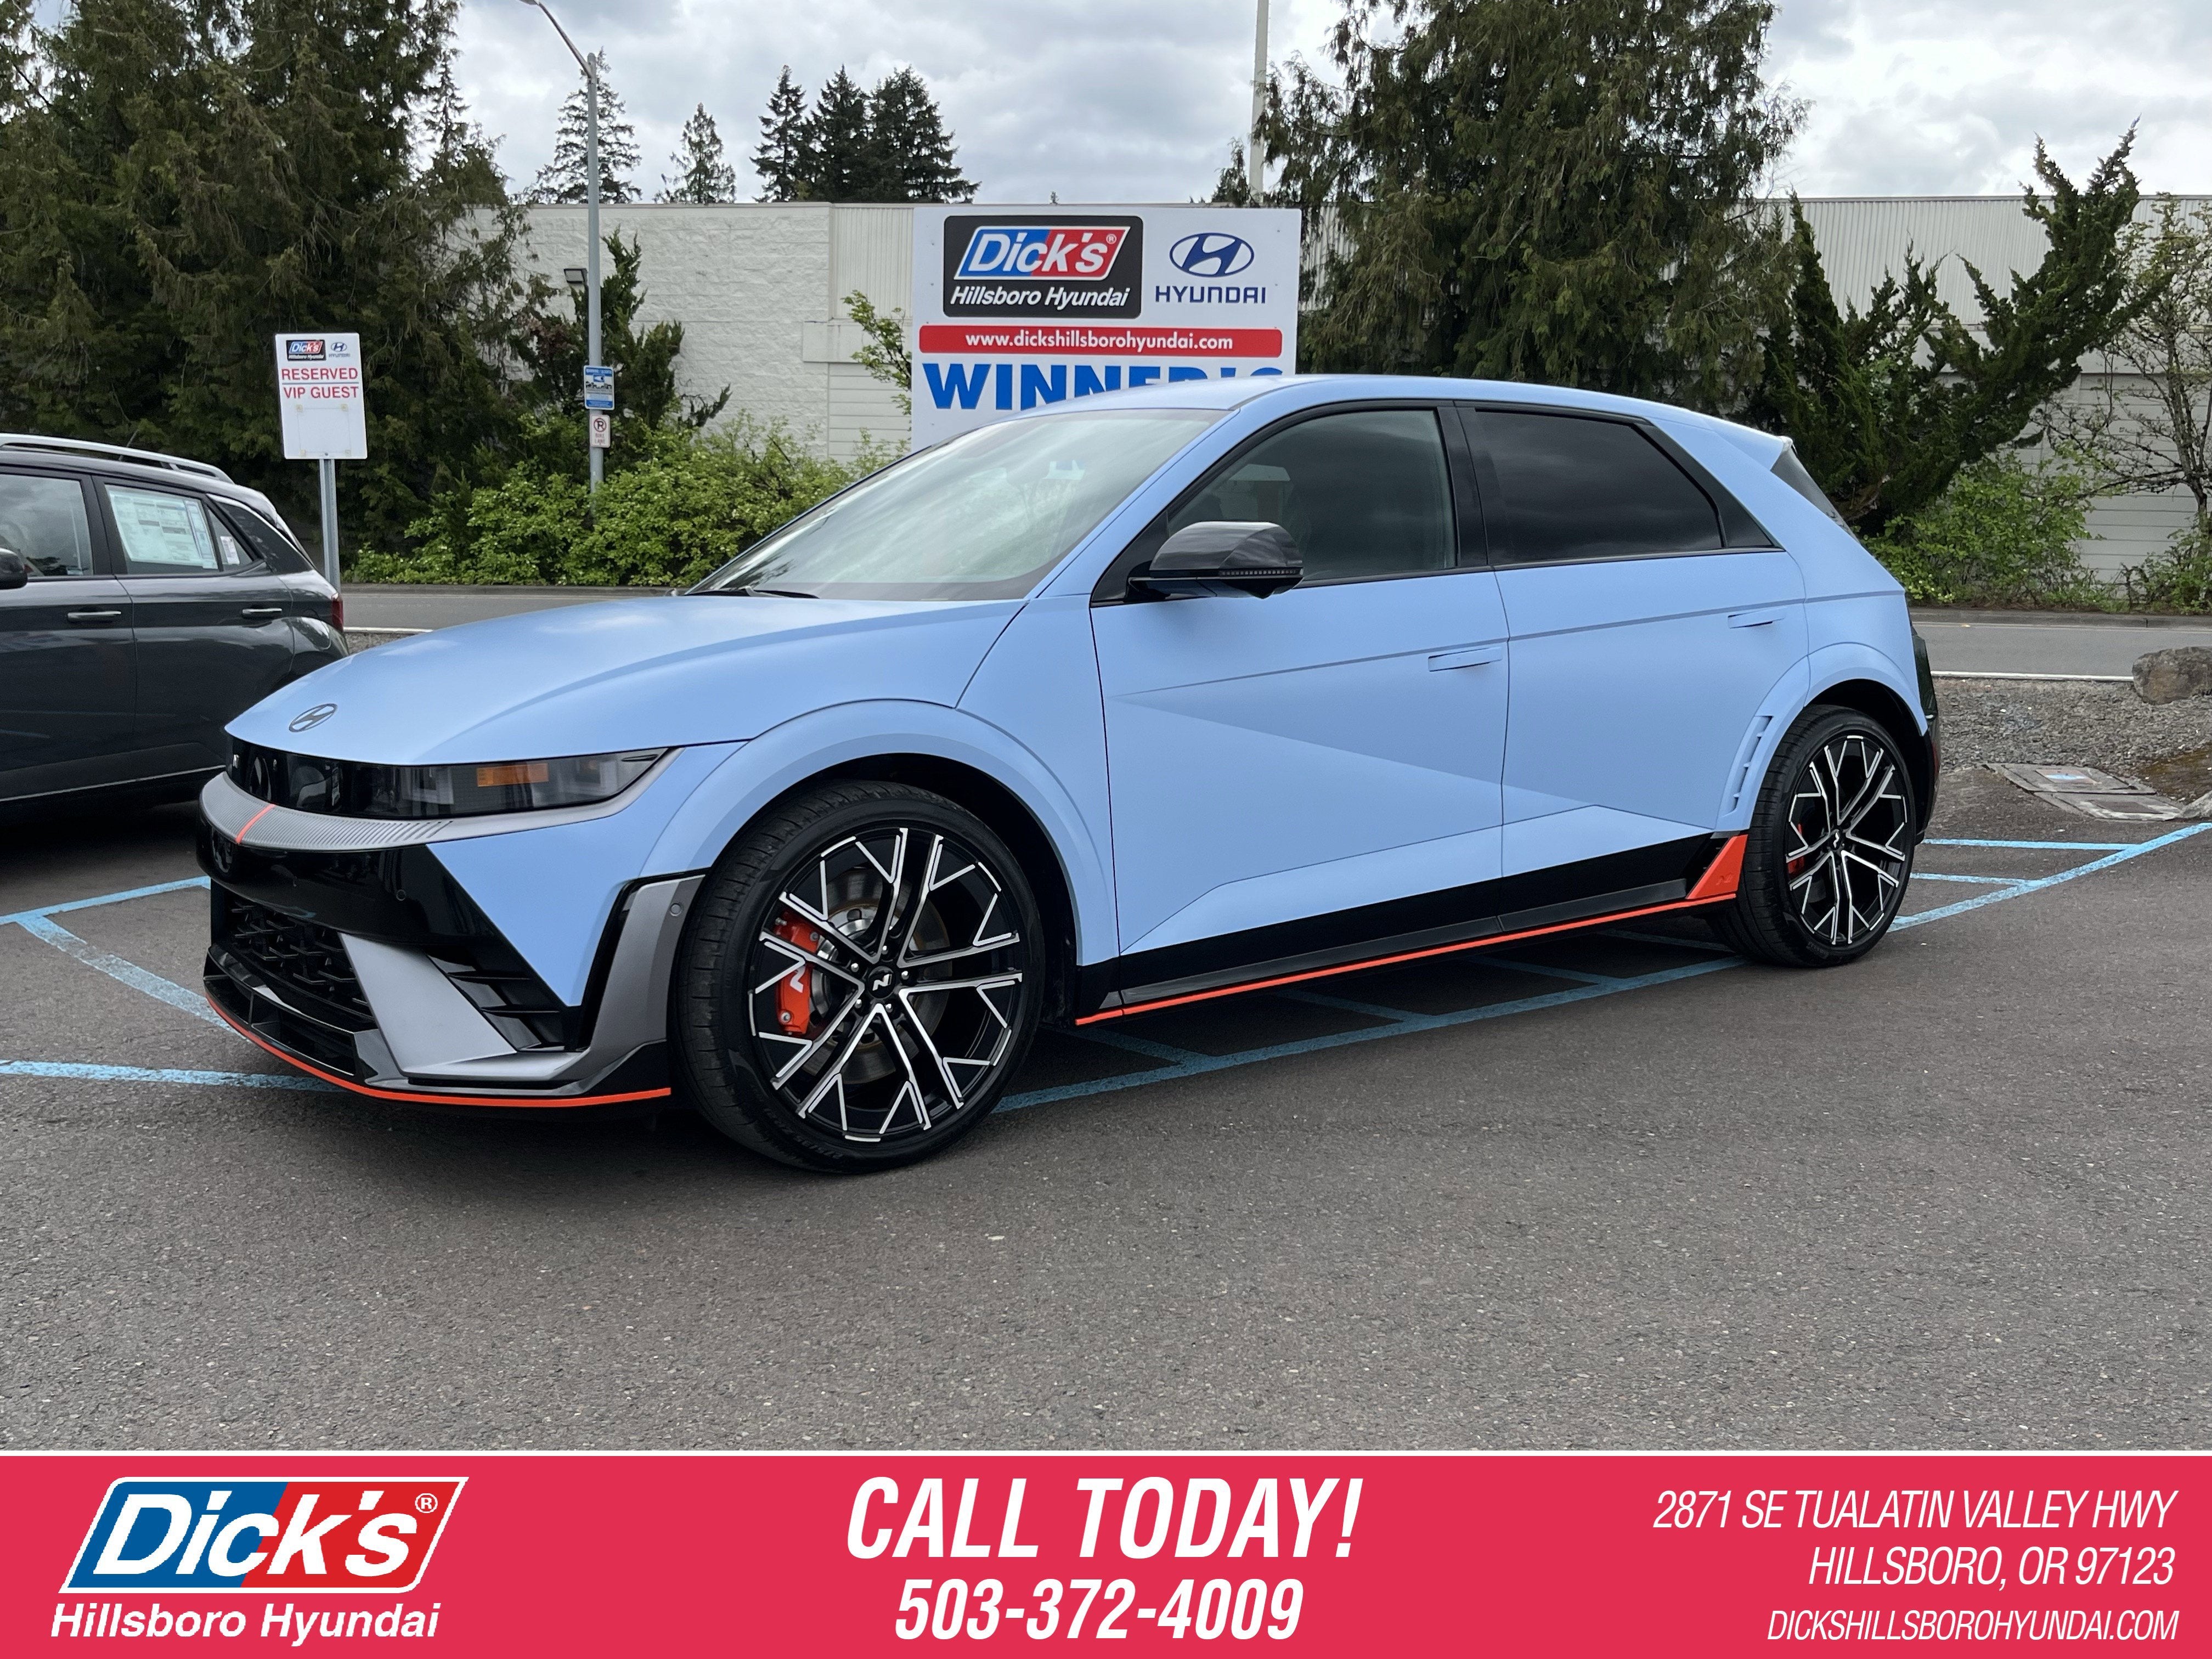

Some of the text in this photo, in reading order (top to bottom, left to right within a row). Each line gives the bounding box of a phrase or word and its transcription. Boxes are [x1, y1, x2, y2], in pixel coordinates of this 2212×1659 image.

[968, 233, 1108, 273] Dick's
[950, 285, 1130, 311] Hillsboro Hyundai
[1155, 286, 1266, 304] HYUNDAI
[966, 330, 1234, 353] www.dickshillsborohyundai.com
[281, 368, 358, 381] RESERVED
[284, 386, 359, 399] VIP GUEST
